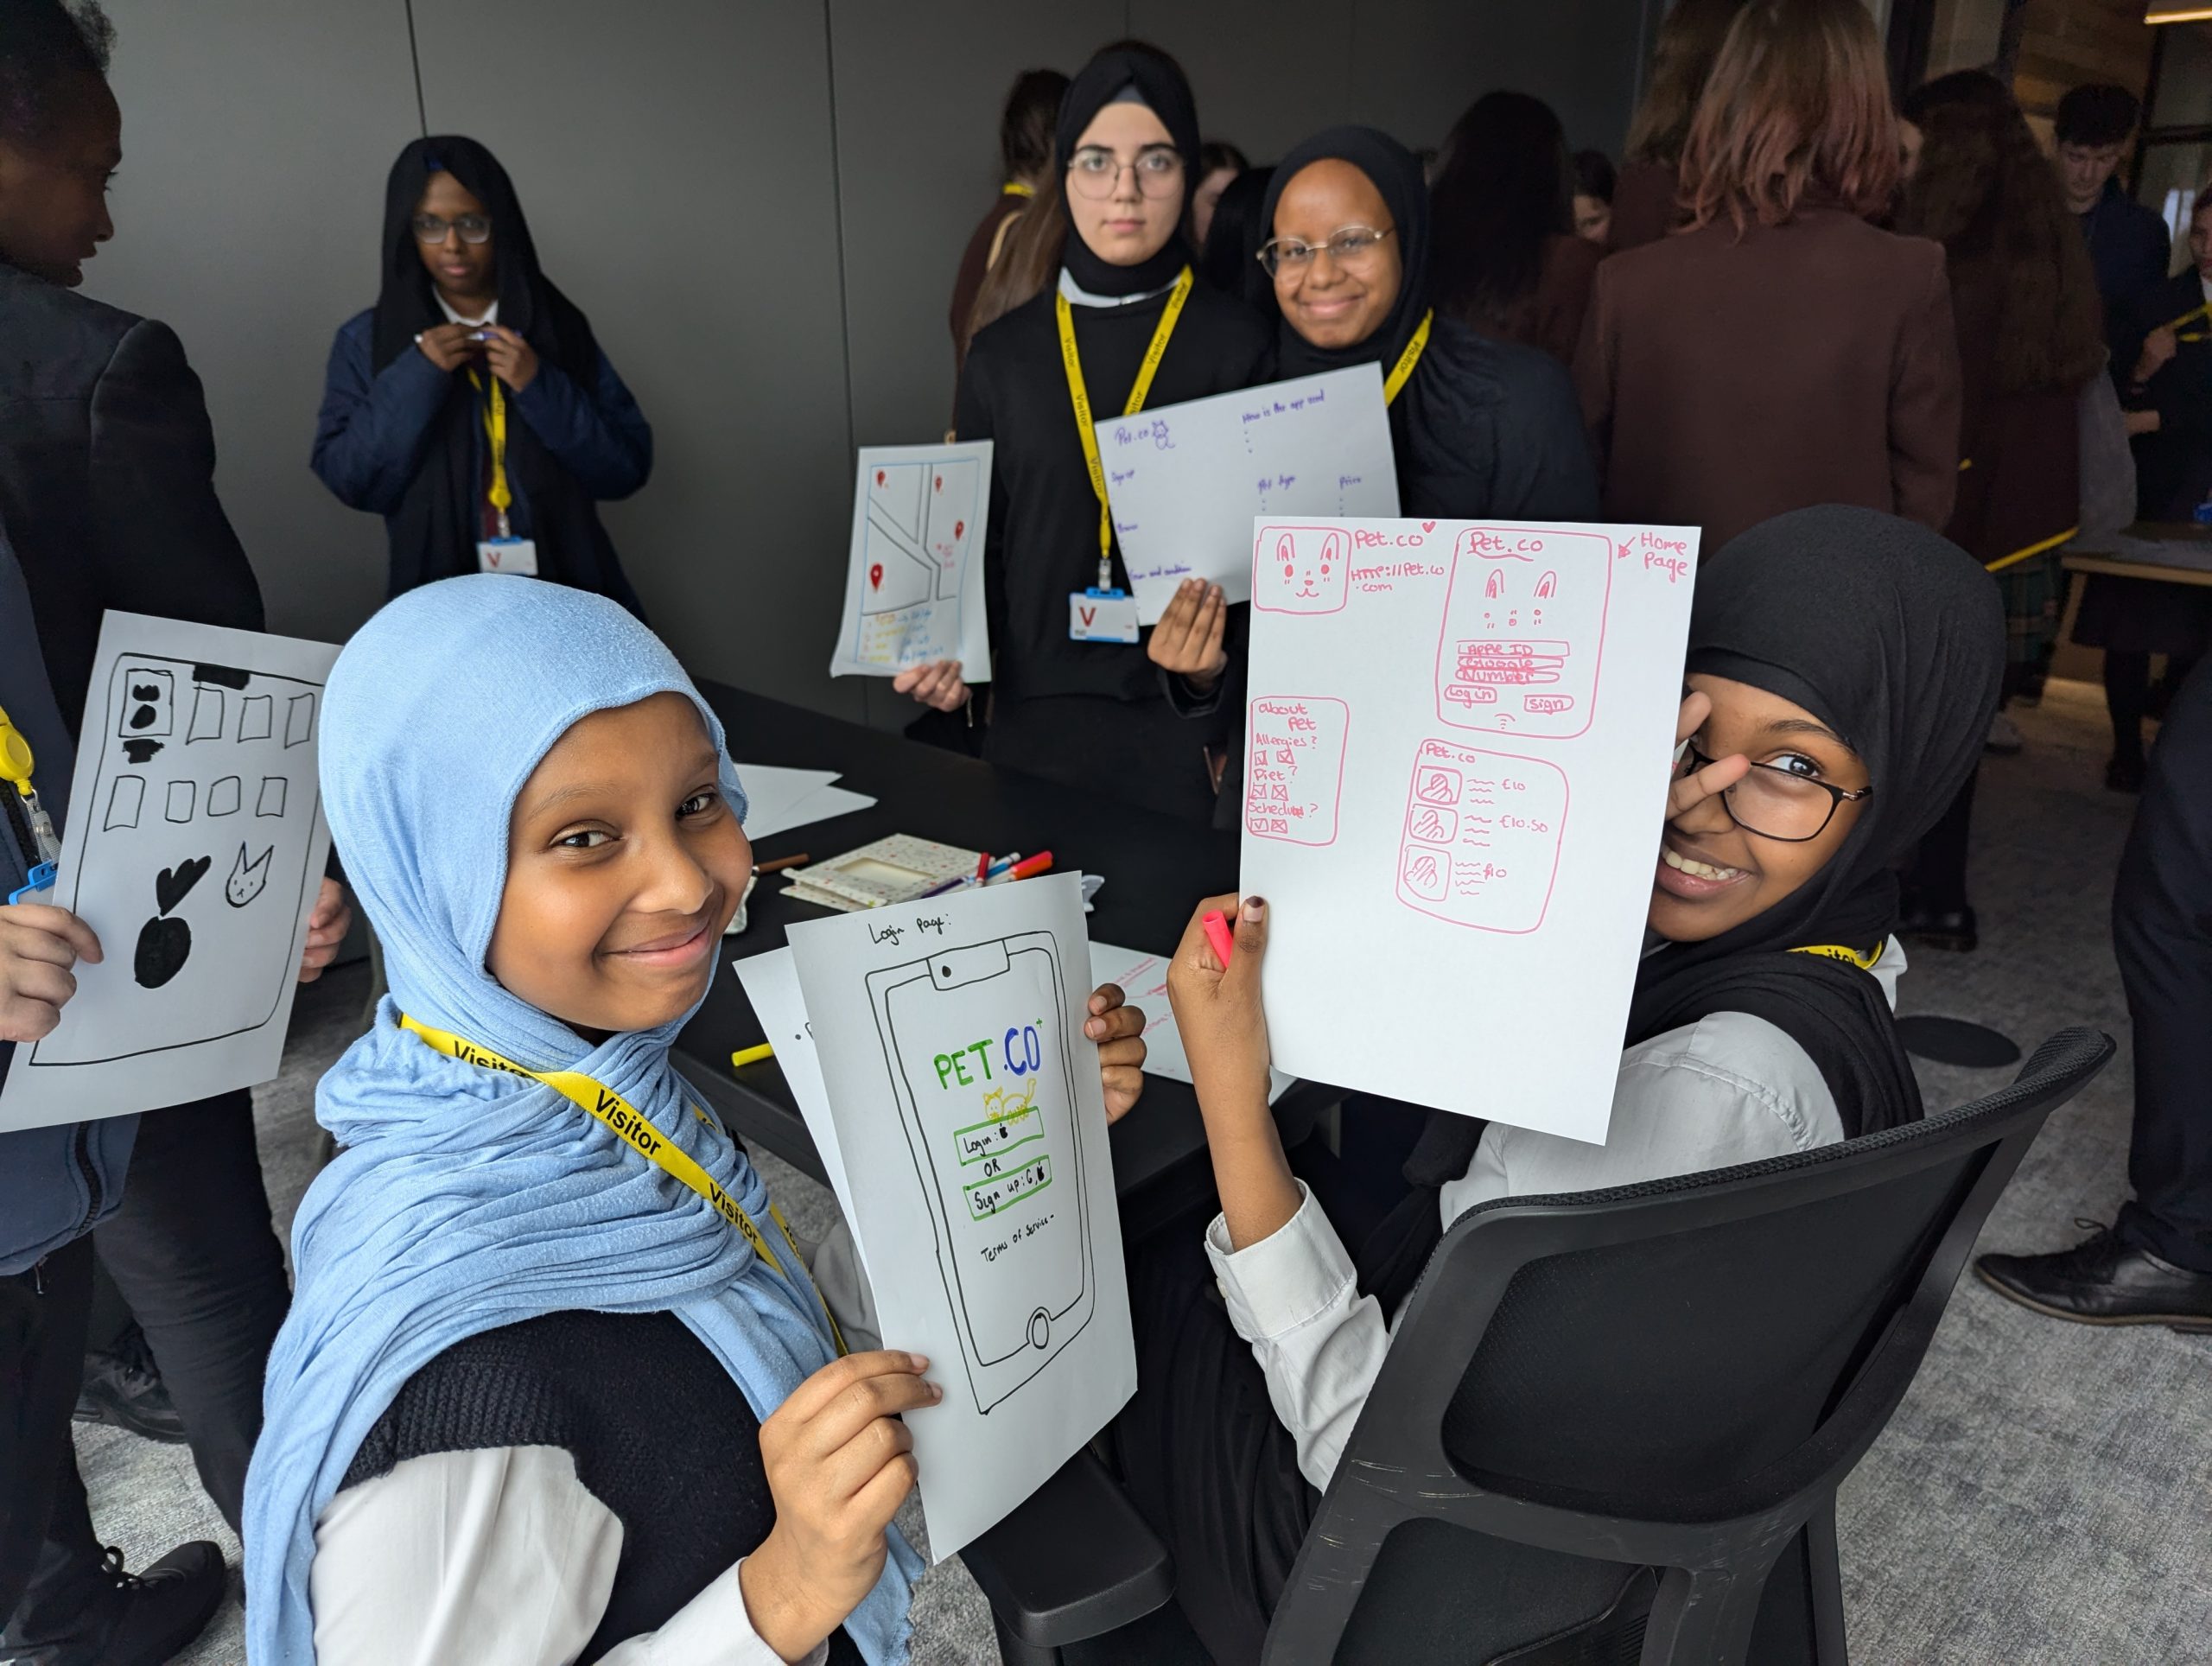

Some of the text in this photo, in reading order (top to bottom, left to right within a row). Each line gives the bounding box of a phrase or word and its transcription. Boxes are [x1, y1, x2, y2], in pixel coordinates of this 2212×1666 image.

[1065, 337, 1075, 367] Visitor
[1147, 334, 1166, 366] Visitor
[1076, 393, 1090, 428] Visitor
[1354, 530, 1424, 550] Pet.co
[1469, 531, 1543, 553] Pet.co
[1641, 531, 1688, 556] Home
[1643, 551, 1688, 583] Page
[1079, 607, 1096, 627] V
[1509, 643, 1535, 657] ID
[1258, 702, 1308, 715] about
[1426, 742, 1476, 764] Pet.co
[868, 923, 905, 946] Login
[595, 1089, 662, 1156] Visitor
[983, 1158, 1001, 1177] OR
[709, 1181, 759, 1245] Visitor
[974, 1191, 1001, 1214] Sign
[981, 1241, 1008, 1262] Terms
[1013, 1229, 1023, 1243] of
